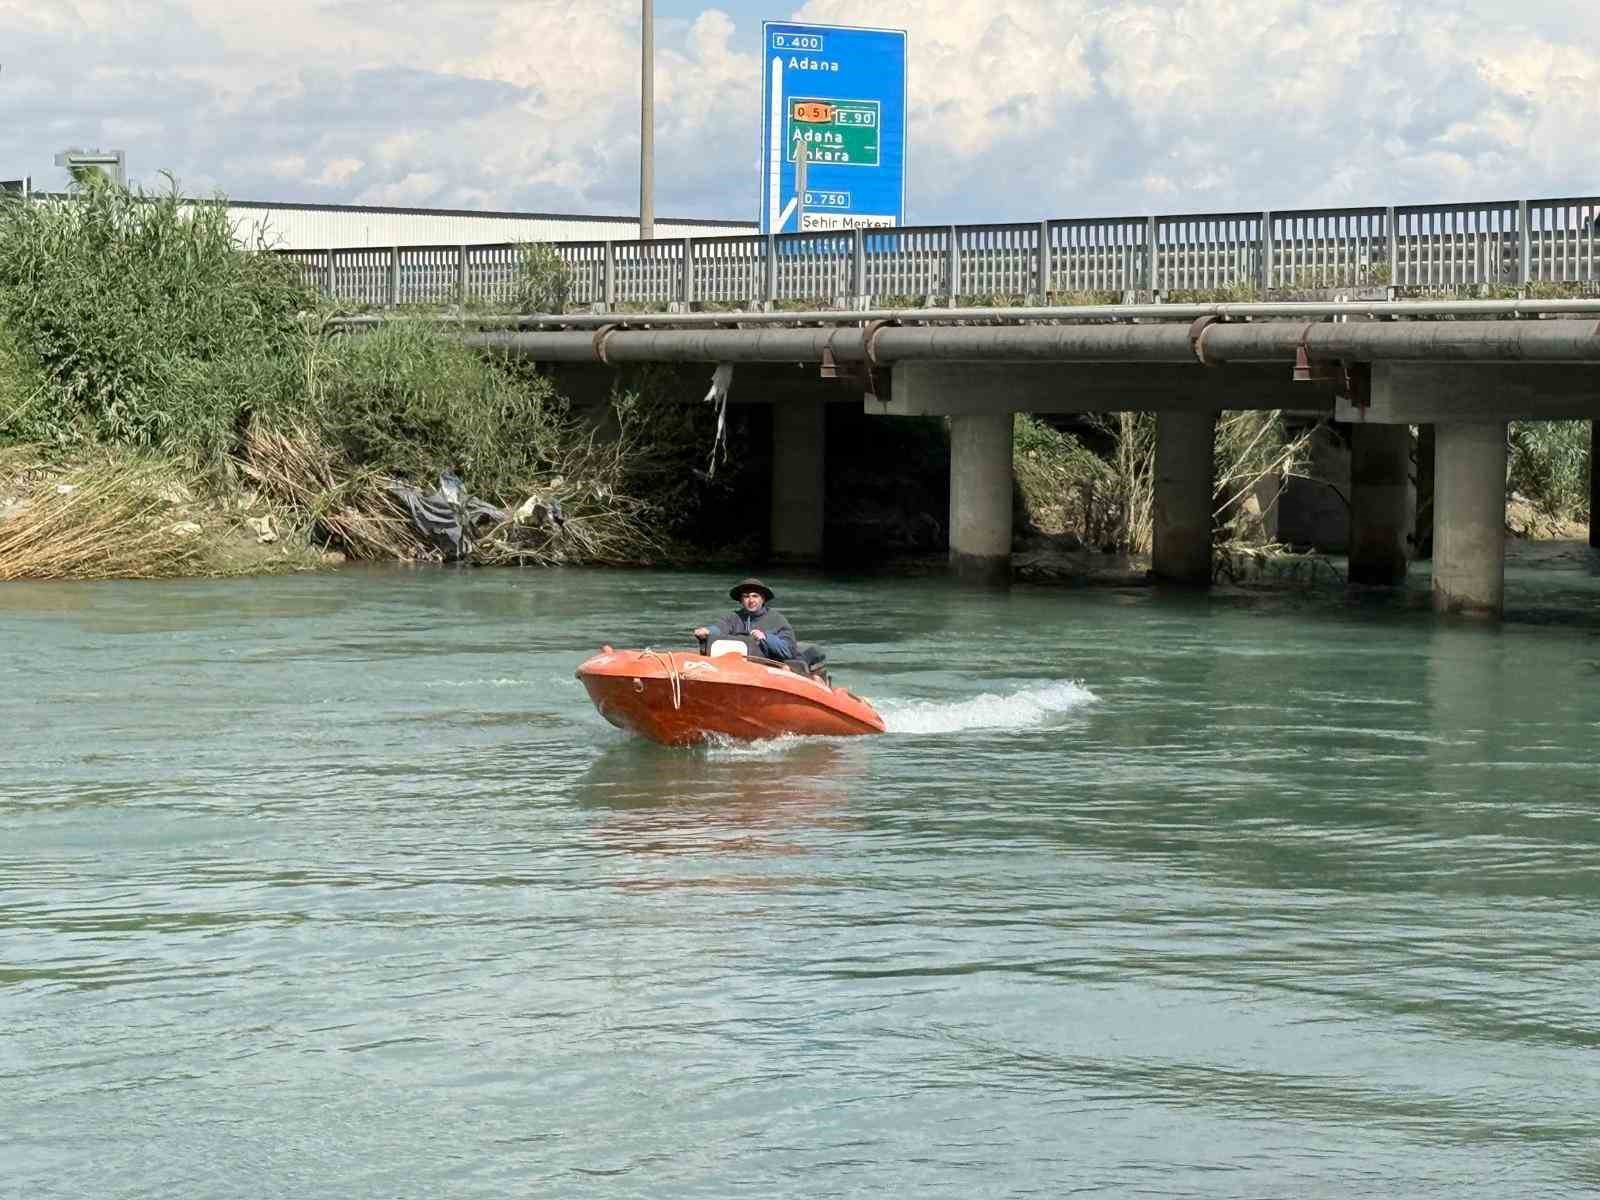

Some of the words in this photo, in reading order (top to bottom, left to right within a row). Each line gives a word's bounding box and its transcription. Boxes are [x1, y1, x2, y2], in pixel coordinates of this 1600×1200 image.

[776, 36, 818, 49] D.400
[788, 56, 839, 72] Adana
[839, 112, 871, 124] E.90
[792, 128, 842, 143] Adana
[804, 193, 845, 205] D.750
